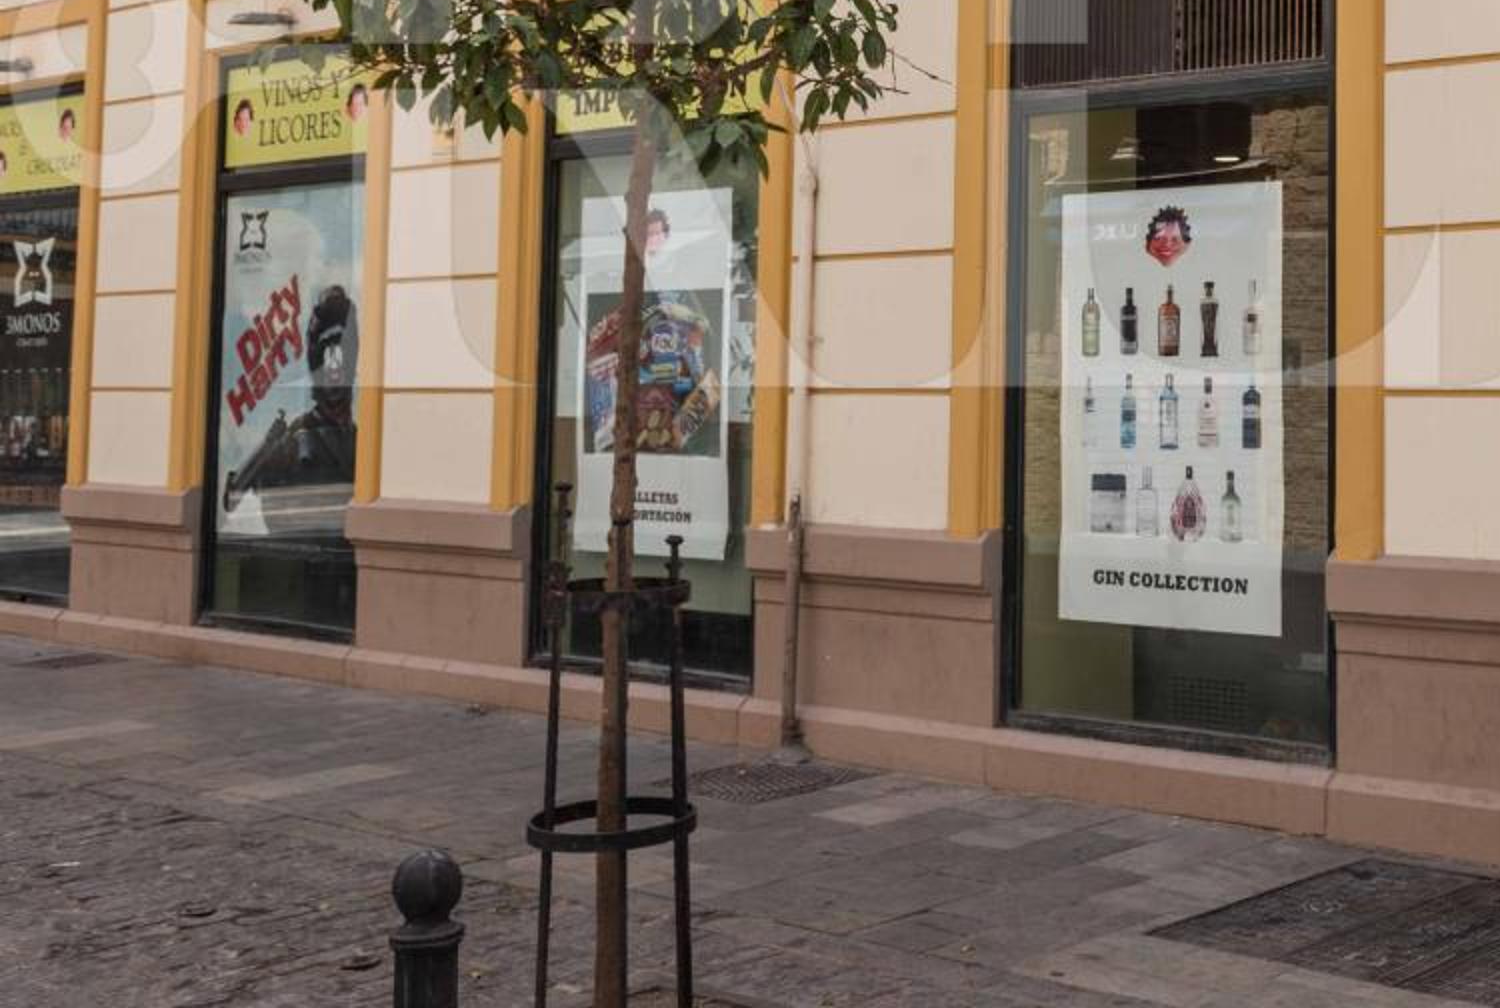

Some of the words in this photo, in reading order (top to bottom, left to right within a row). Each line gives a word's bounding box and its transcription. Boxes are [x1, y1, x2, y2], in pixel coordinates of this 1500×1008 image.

[261, 73, 322, 108] VINOS
[258, 109, 343, 147] LICORES
[5, 311, 61, 335] 3MONOS
[236, 273, 302, 376] Dirty
[225, 314, 304, 428] Harry
[1093, 569, 1125, 587] GIN
[1129, 570, 1249, 595] COLLECTION
